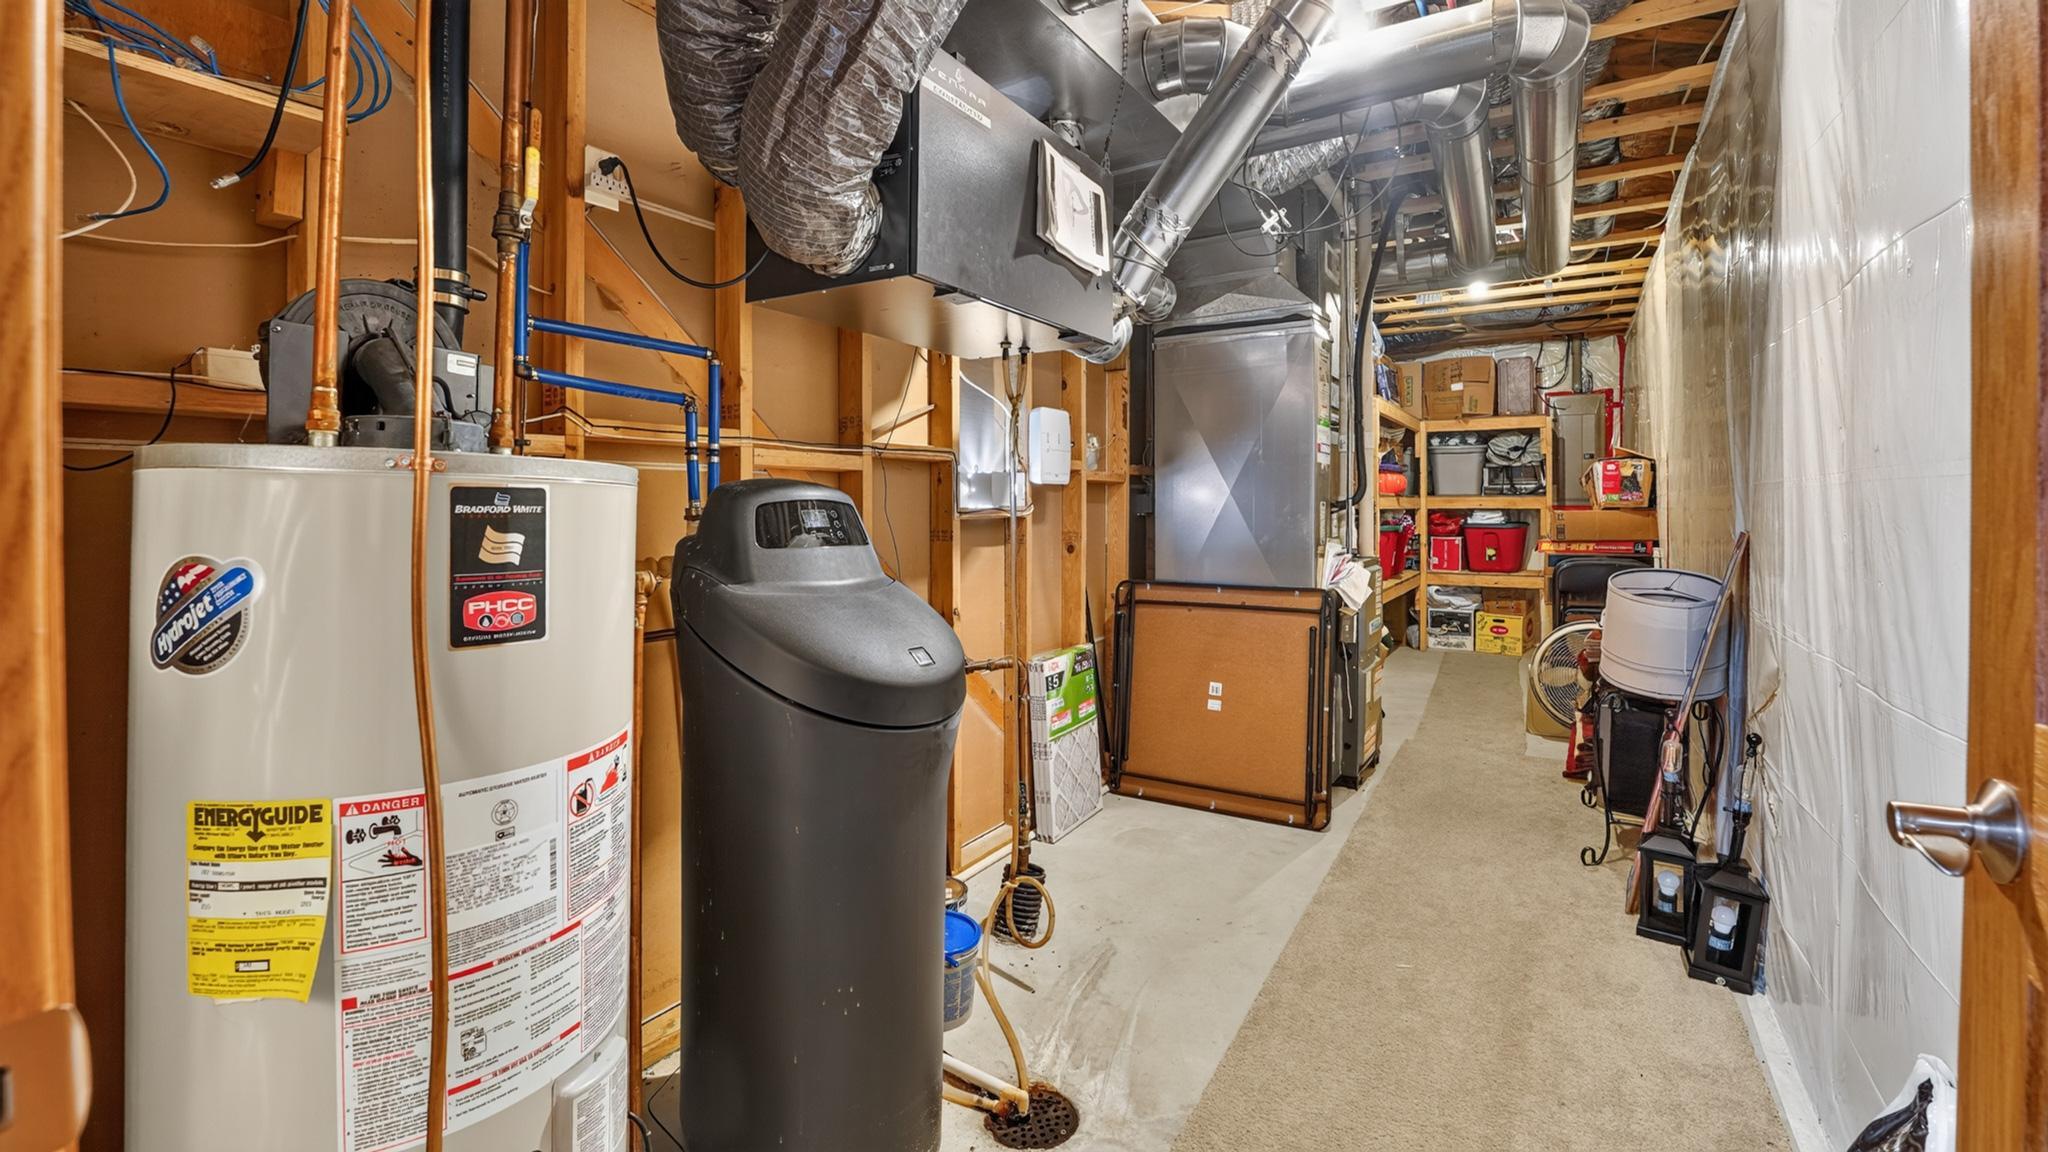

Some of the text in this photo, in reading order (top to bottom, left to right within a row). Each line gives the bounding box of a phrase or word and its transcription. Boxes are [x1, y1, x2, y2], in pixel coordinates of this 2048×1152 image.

[454, 504, 511, 514] BRADFORD
[468, 598, 534, 615] PHCC
[157, 591, 214, 656] Hydrojet
[361, 796, 420, 813] DANGER
[194, 804, 323, 827] ENERGYGUIDE
